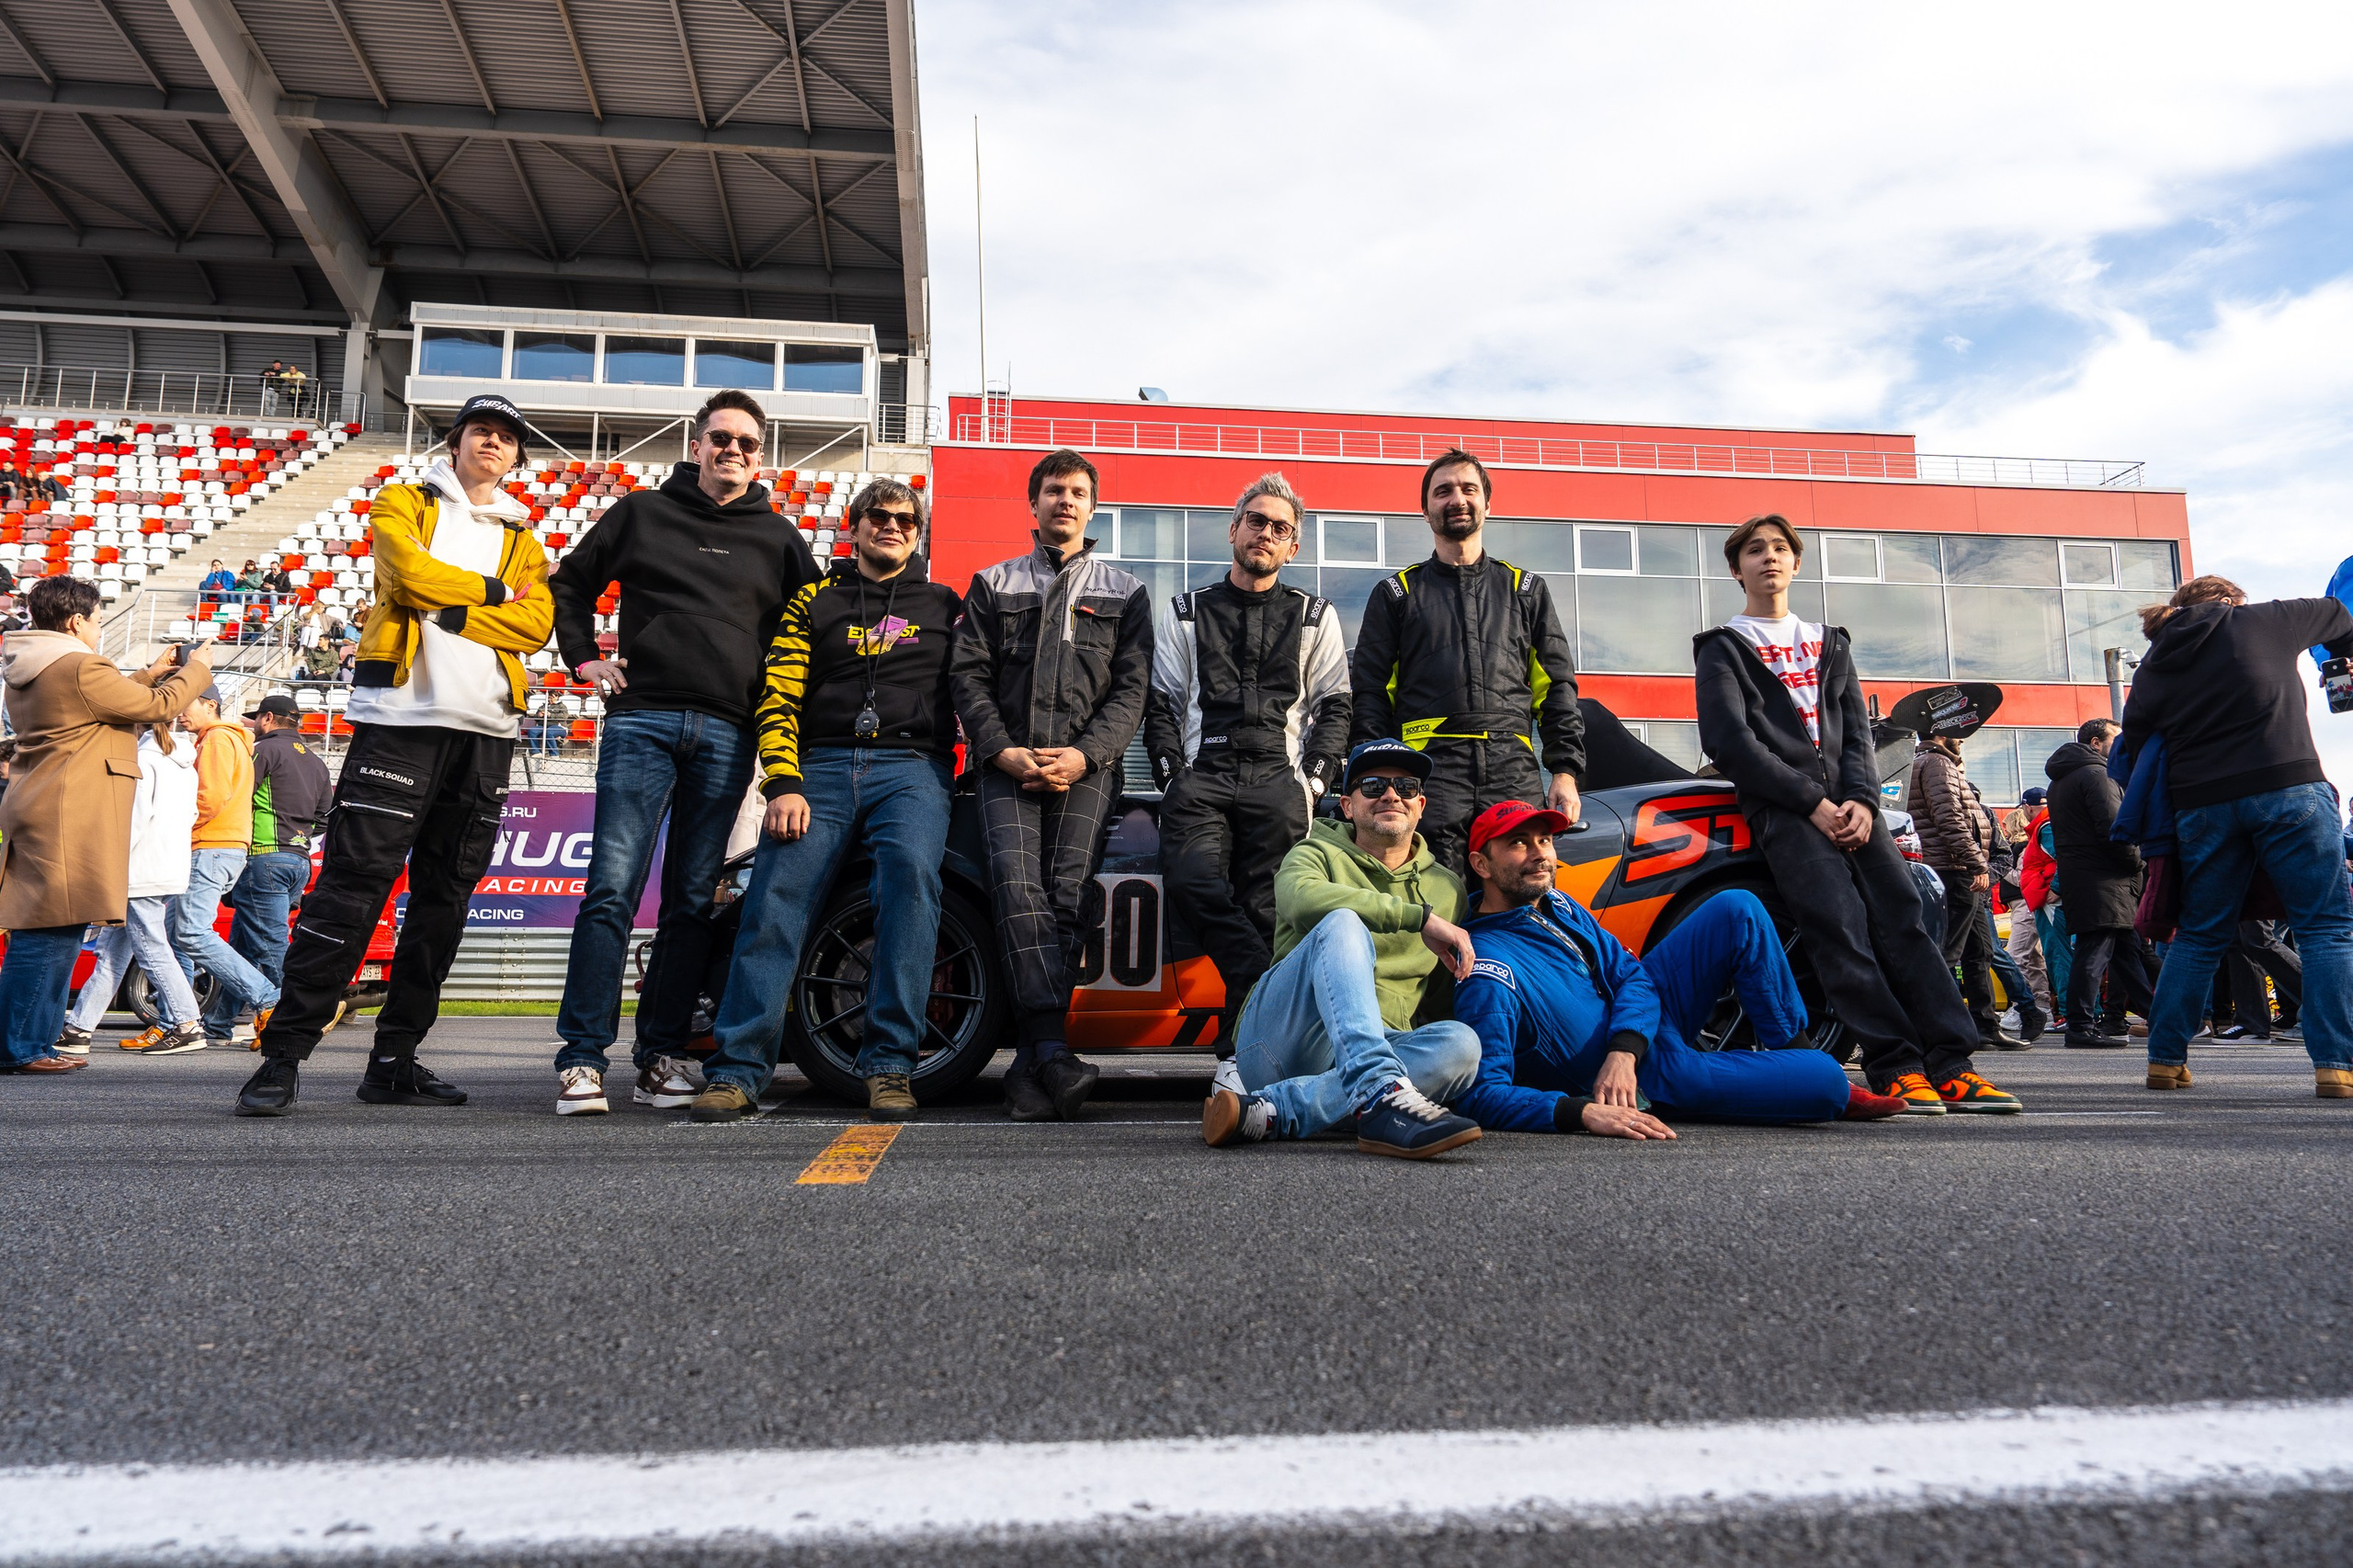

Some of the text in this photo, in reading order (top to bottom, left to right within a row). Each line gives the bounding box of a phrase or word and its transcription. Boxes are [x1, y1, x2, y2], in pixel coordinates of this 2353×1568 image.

[1386, 577, 1404, 597] sparco
[1521, 573, 1534, 591] sparco
[1311, 597, 1325, 619] sparco
[1405, 722, 1430, 736] sparco
[1204, 735, 1228, 744] sparco
[1313, 759, 1325, 776] arco
[359, 767, 414, 786] BLACK SQUAD
[476, 879, 585, 893] ACING
[467, 909, 524, 920] ACING
